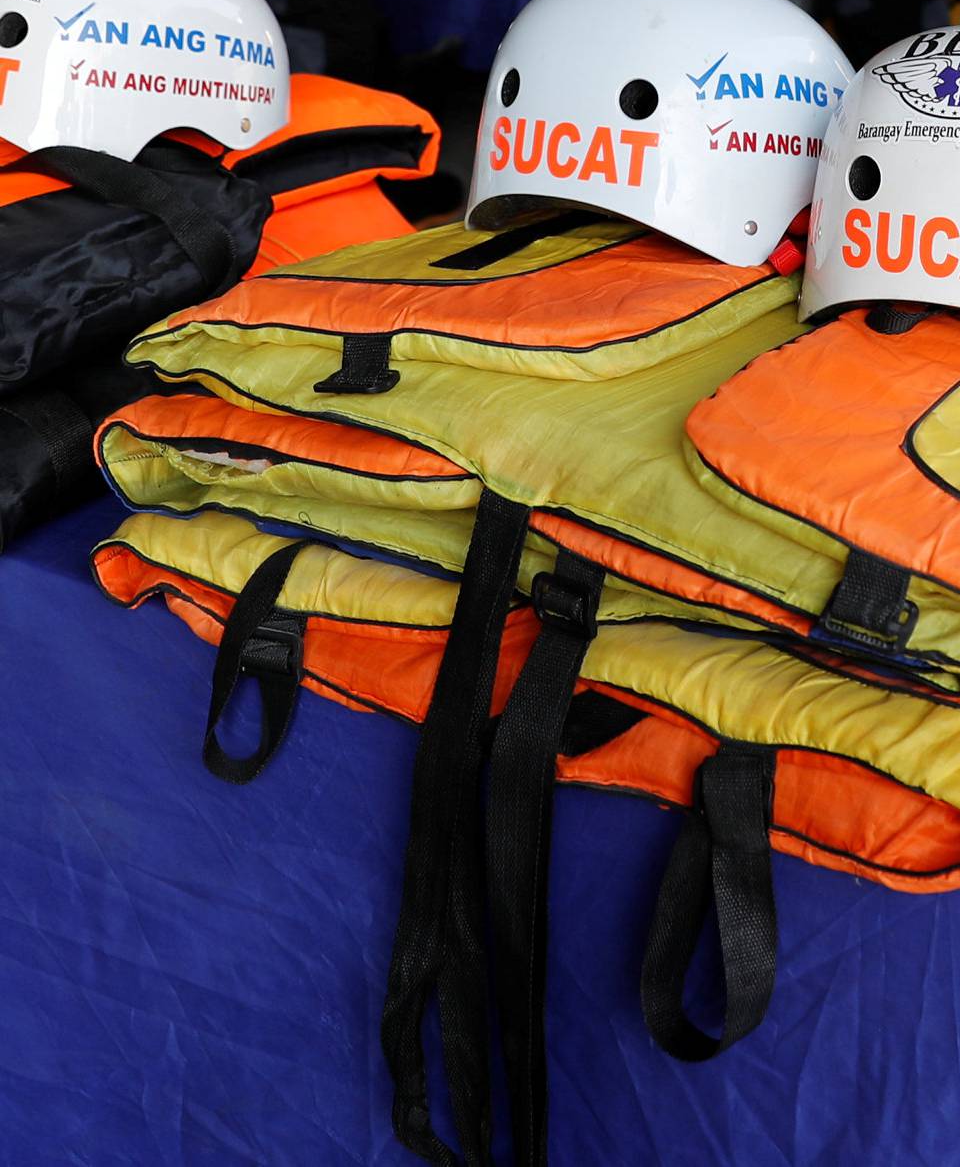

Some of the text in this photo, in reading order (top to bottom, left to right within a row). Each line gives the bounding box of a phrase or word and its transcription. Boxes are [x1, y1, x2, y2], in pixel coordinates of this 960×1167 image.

[141, 24, 205, 53] ANG
[215, 34, 275, 69] TAMA
[124, 73, 166, 93] ANG
[775, 74, 828, 108] ANG
[763, 133, 801, 156] ANG
[858, 123, 902, 142] Barangay
[490, 116, 660, 187] SUCAT
